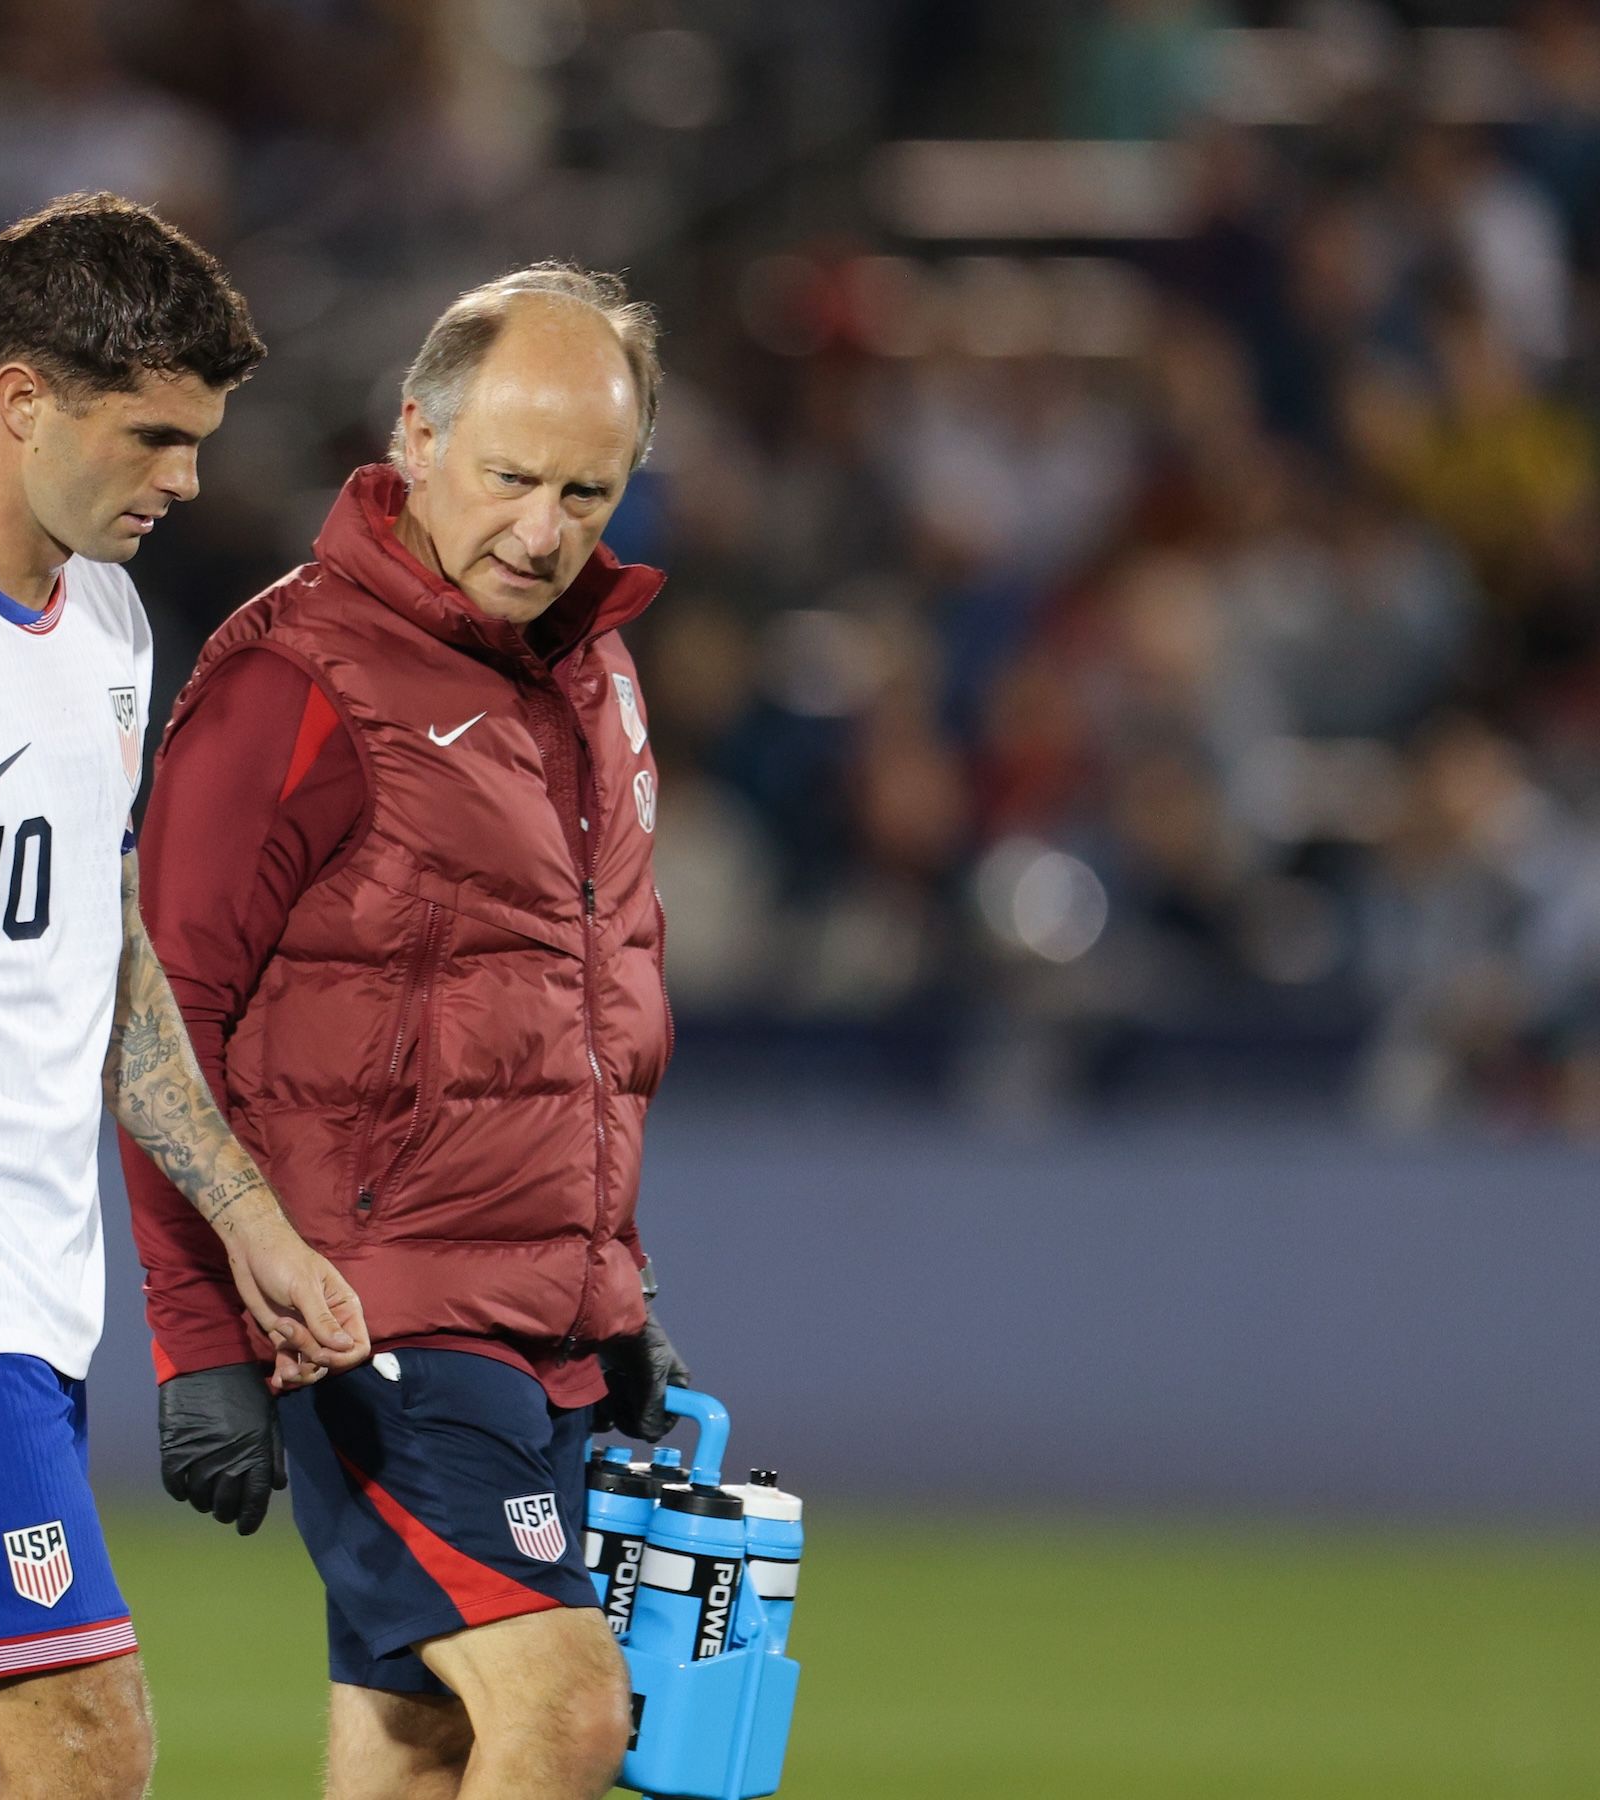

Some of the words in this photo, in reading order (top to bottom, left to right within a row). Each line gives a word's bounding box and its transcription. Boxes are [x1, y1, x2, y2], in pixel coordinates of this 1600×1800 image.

[111, 693, 134, 731] USA
[507, 1497, 554, 1528] USA
[8, 1525, 62, 1561] USA
